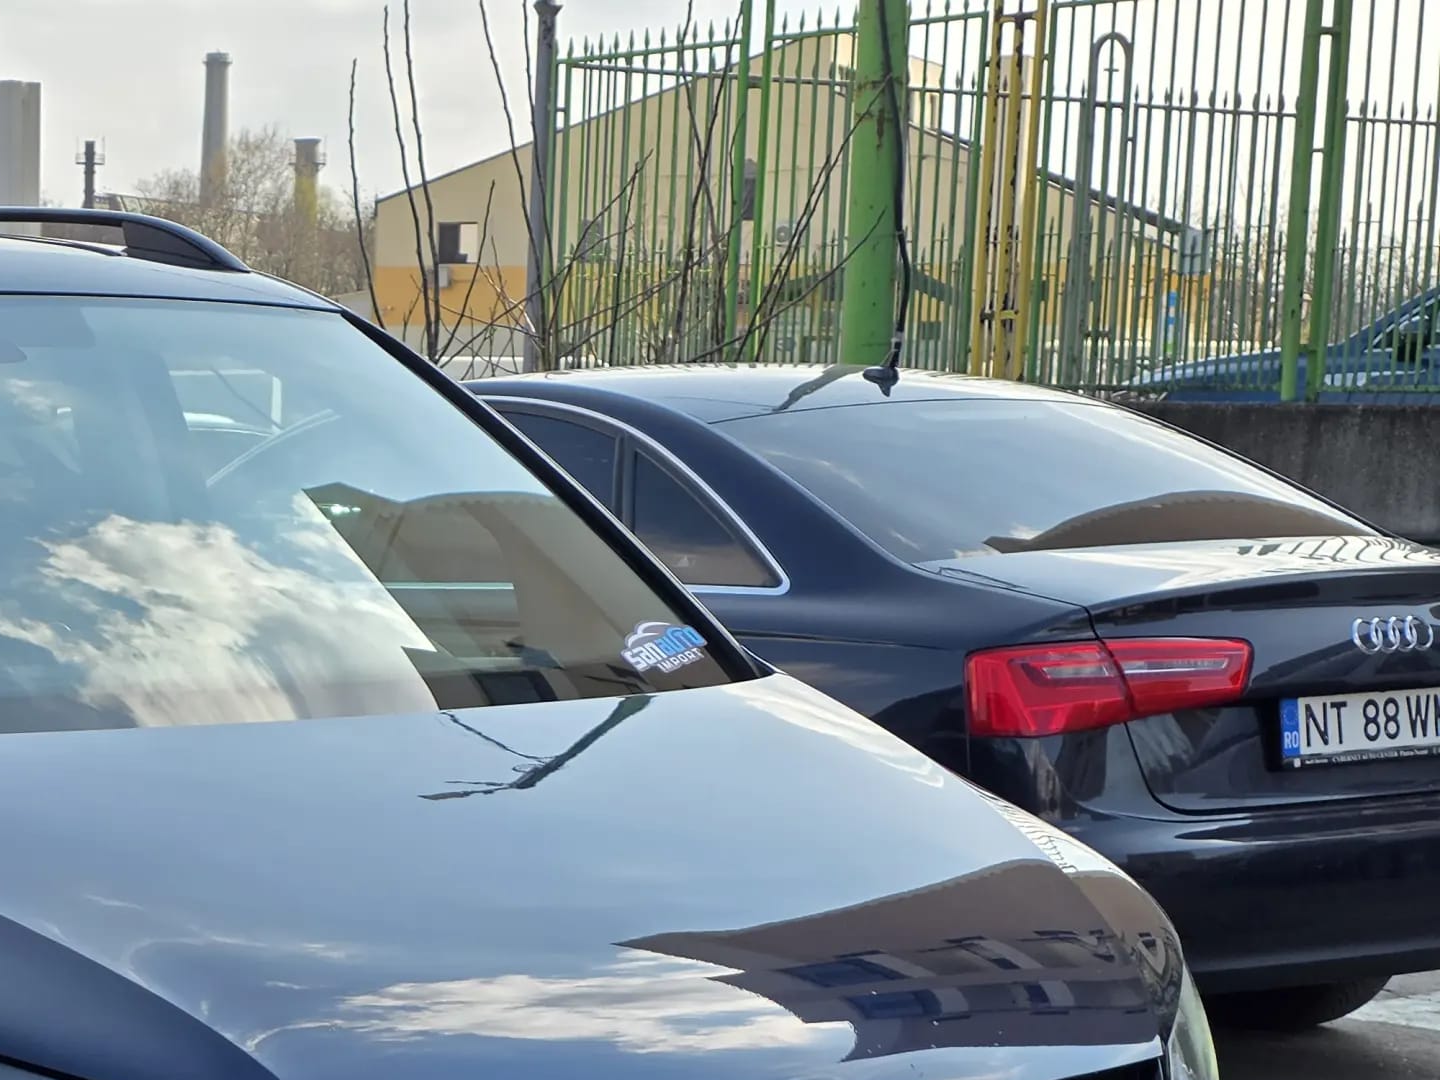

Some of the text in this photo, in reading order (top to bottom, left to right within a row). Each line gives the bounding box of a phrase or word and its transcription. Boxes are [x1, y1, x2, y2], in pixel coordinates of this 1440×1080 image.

[657, 647, 704, 673] IMPORT
[1305, 701, 1348, 747] NT
[1363, 697, 1400, 741] 88
[1284, 731, 1299, 749] RO
